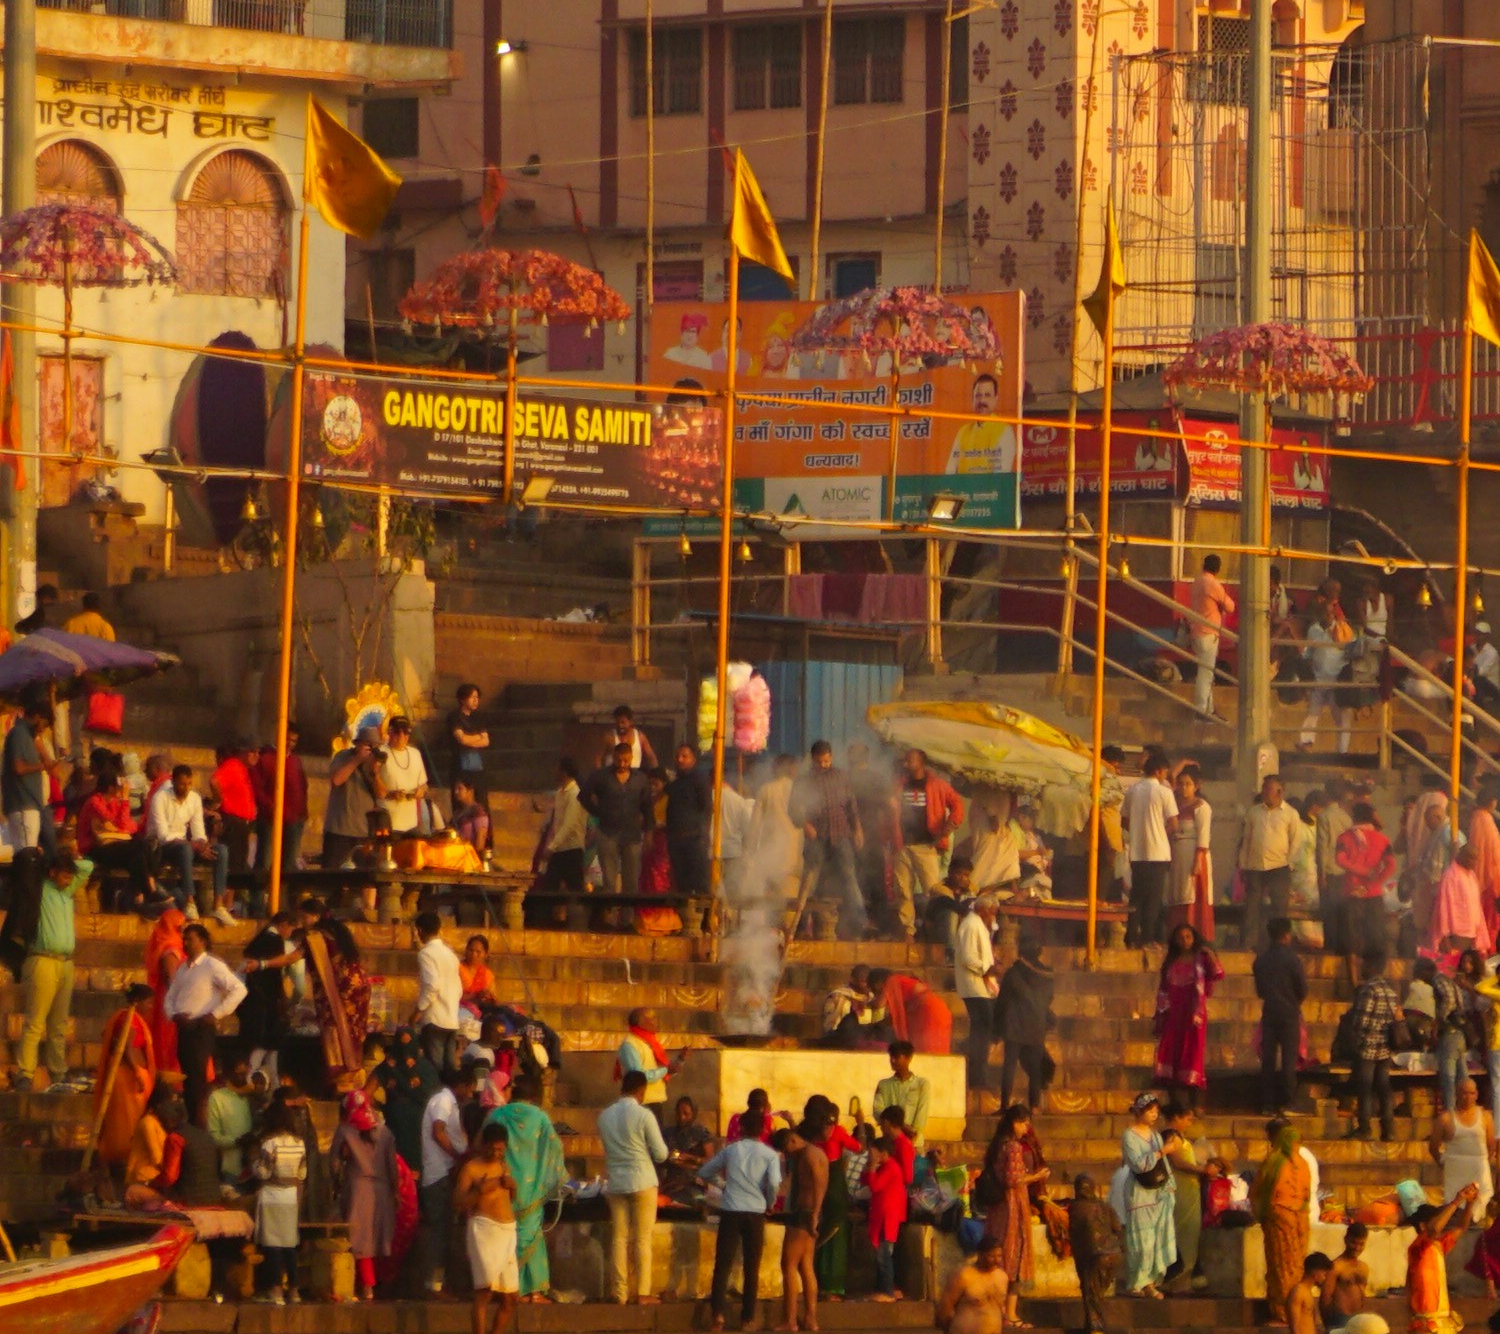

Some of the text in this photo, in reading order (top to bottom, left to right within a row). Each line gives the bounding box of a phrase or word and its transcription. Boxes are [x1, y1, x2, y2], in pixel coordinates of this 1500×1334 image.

[191, 110, 276, 142] घाट
[383, 388, 652, 447] GANGOTRI SEVA SAMITI
[774, 418, 815, 442] गंगा
[820, 419, 845, 441] को
[821, 486, 871, 502] ATOMIC
